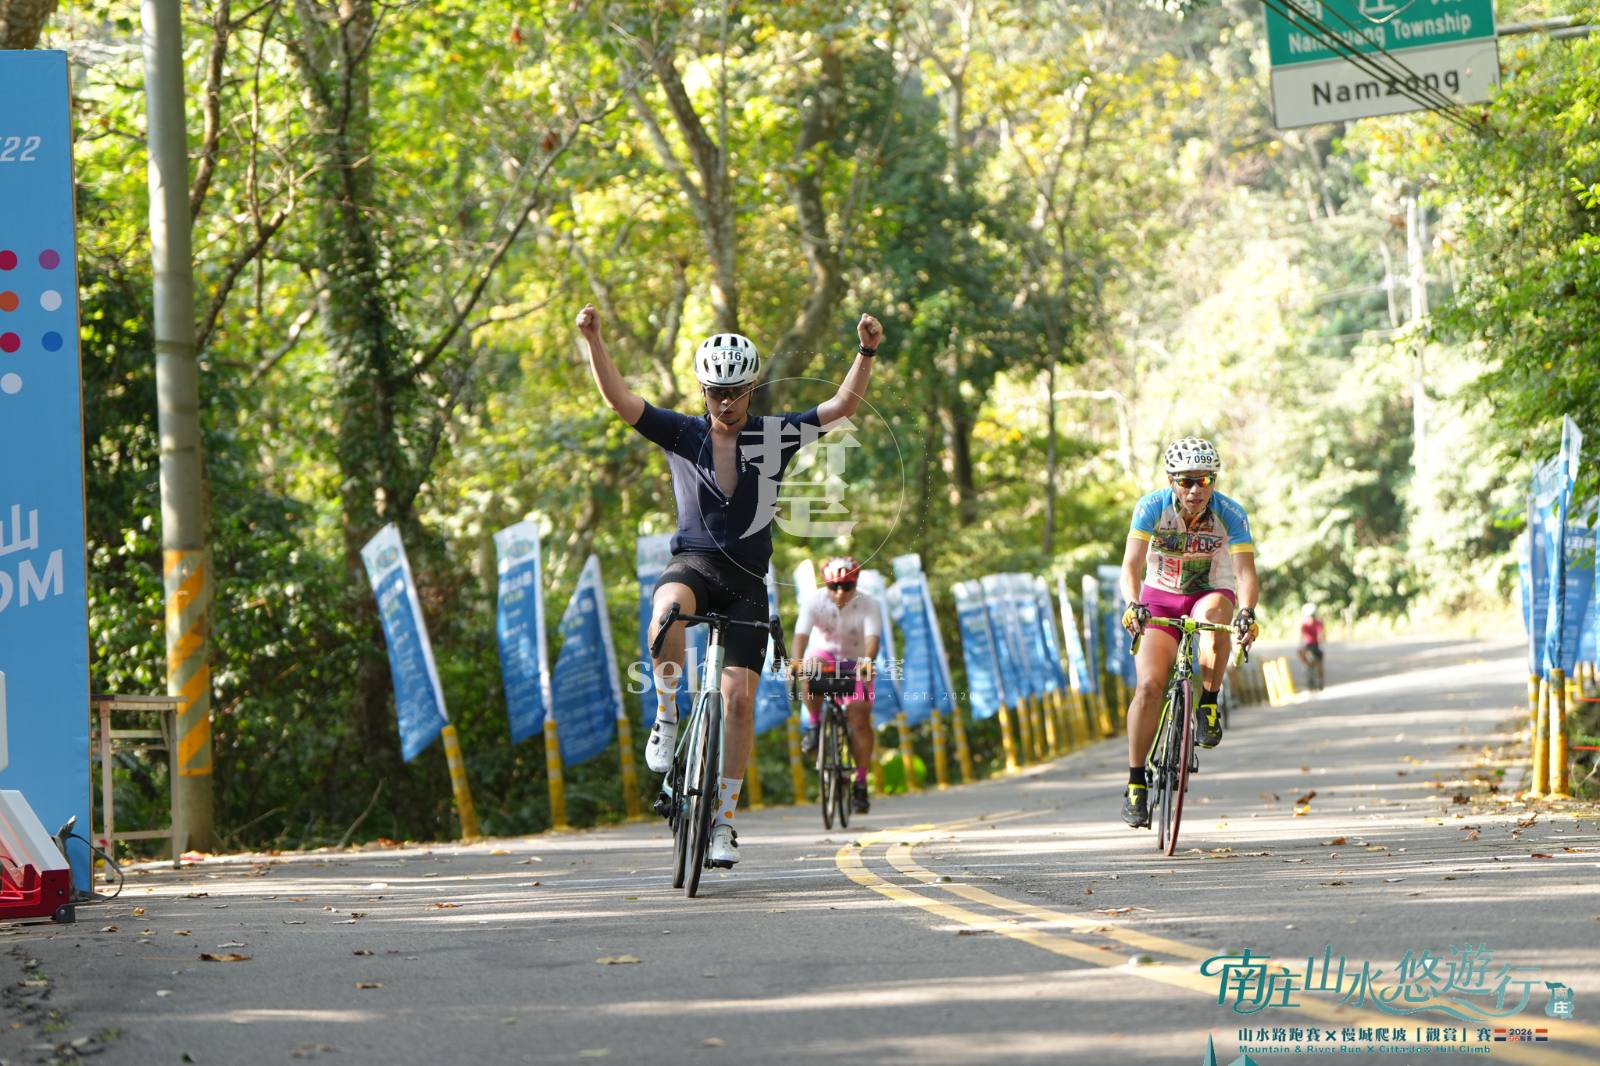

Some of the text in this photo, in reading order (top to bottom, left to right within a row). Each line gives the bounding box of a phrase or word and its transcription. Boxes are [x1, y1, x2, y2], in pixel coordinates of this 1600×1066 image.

[1391, 9, 1472, 39] Township
[1312, 68, 1460, 106] Namzong
[0, 135, 41, 162] 22
